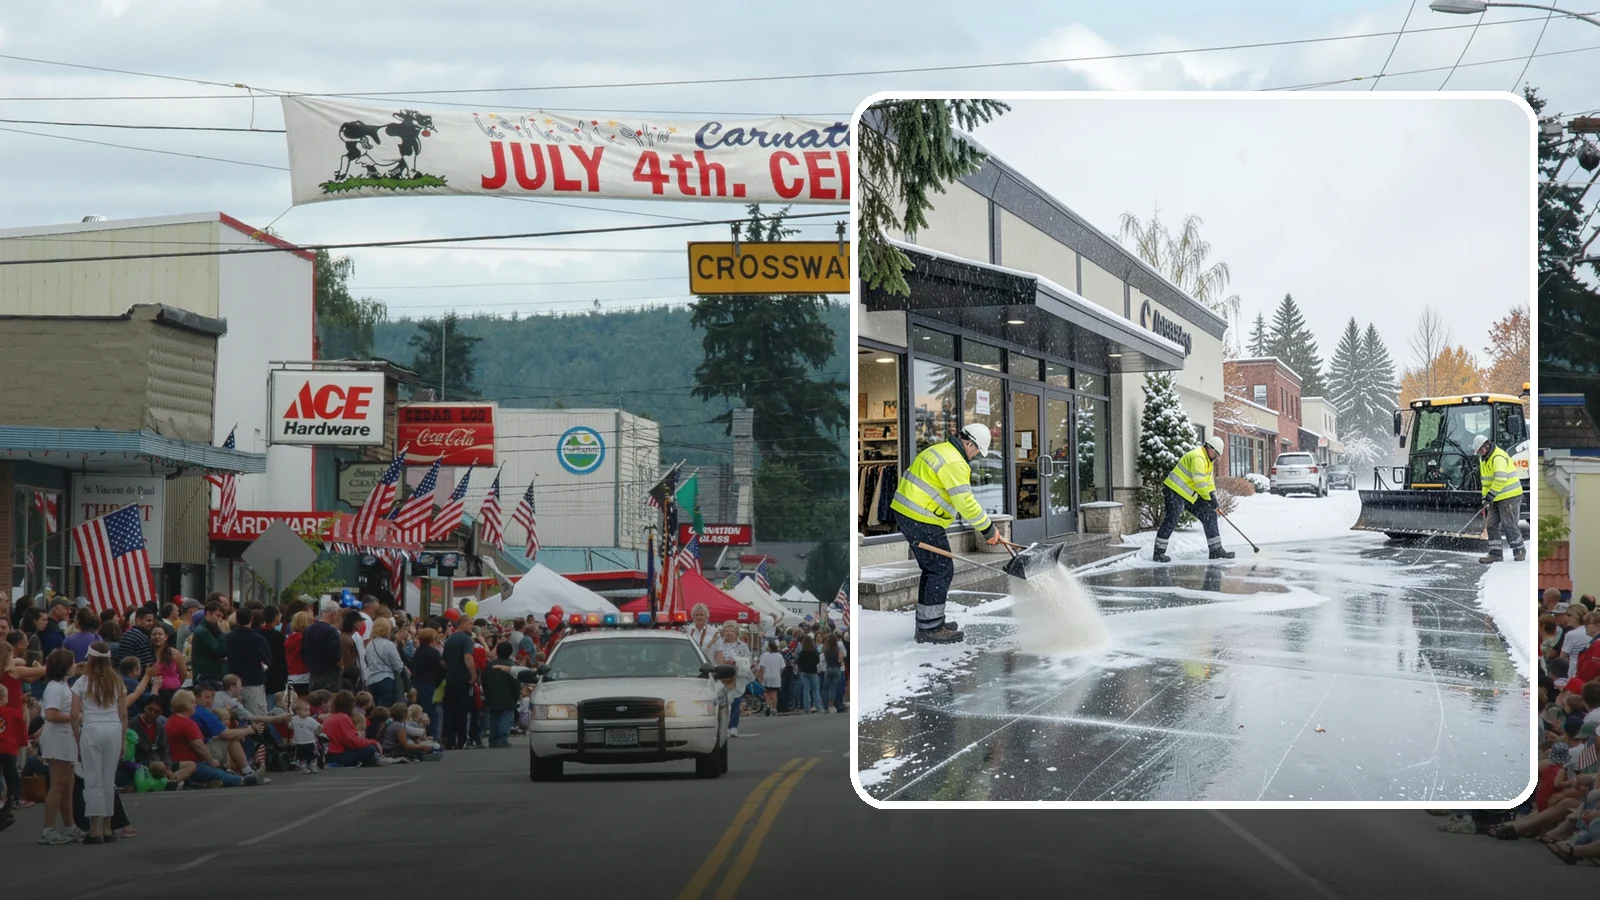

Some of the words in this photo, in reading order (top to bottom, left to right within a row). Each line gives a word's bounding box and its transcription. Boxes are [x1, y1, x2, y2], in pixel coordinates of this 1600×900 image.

[481, 141, 604, 193] JULY
[632, 150, 746, 198] 4th.
[697, 254, 850, 280] CROSSWA
[282, 380, 373, 420] ACE
[405, 409, 452, 422] CEDAR
[461, 409, 485, 422] LOG
[283, 421, 370, 436] Hardware
[416, 428, 477, 447] Coca-Cola
[83, 485, 93, 494] St.
[96, 485, 124, 495] Vincent
[126, 486, 136, 495] de
[138, 486, 155, 495] Paul
[688, 526, 741, 535] CRNATION
[699, 535, 730, 543] GLASS
